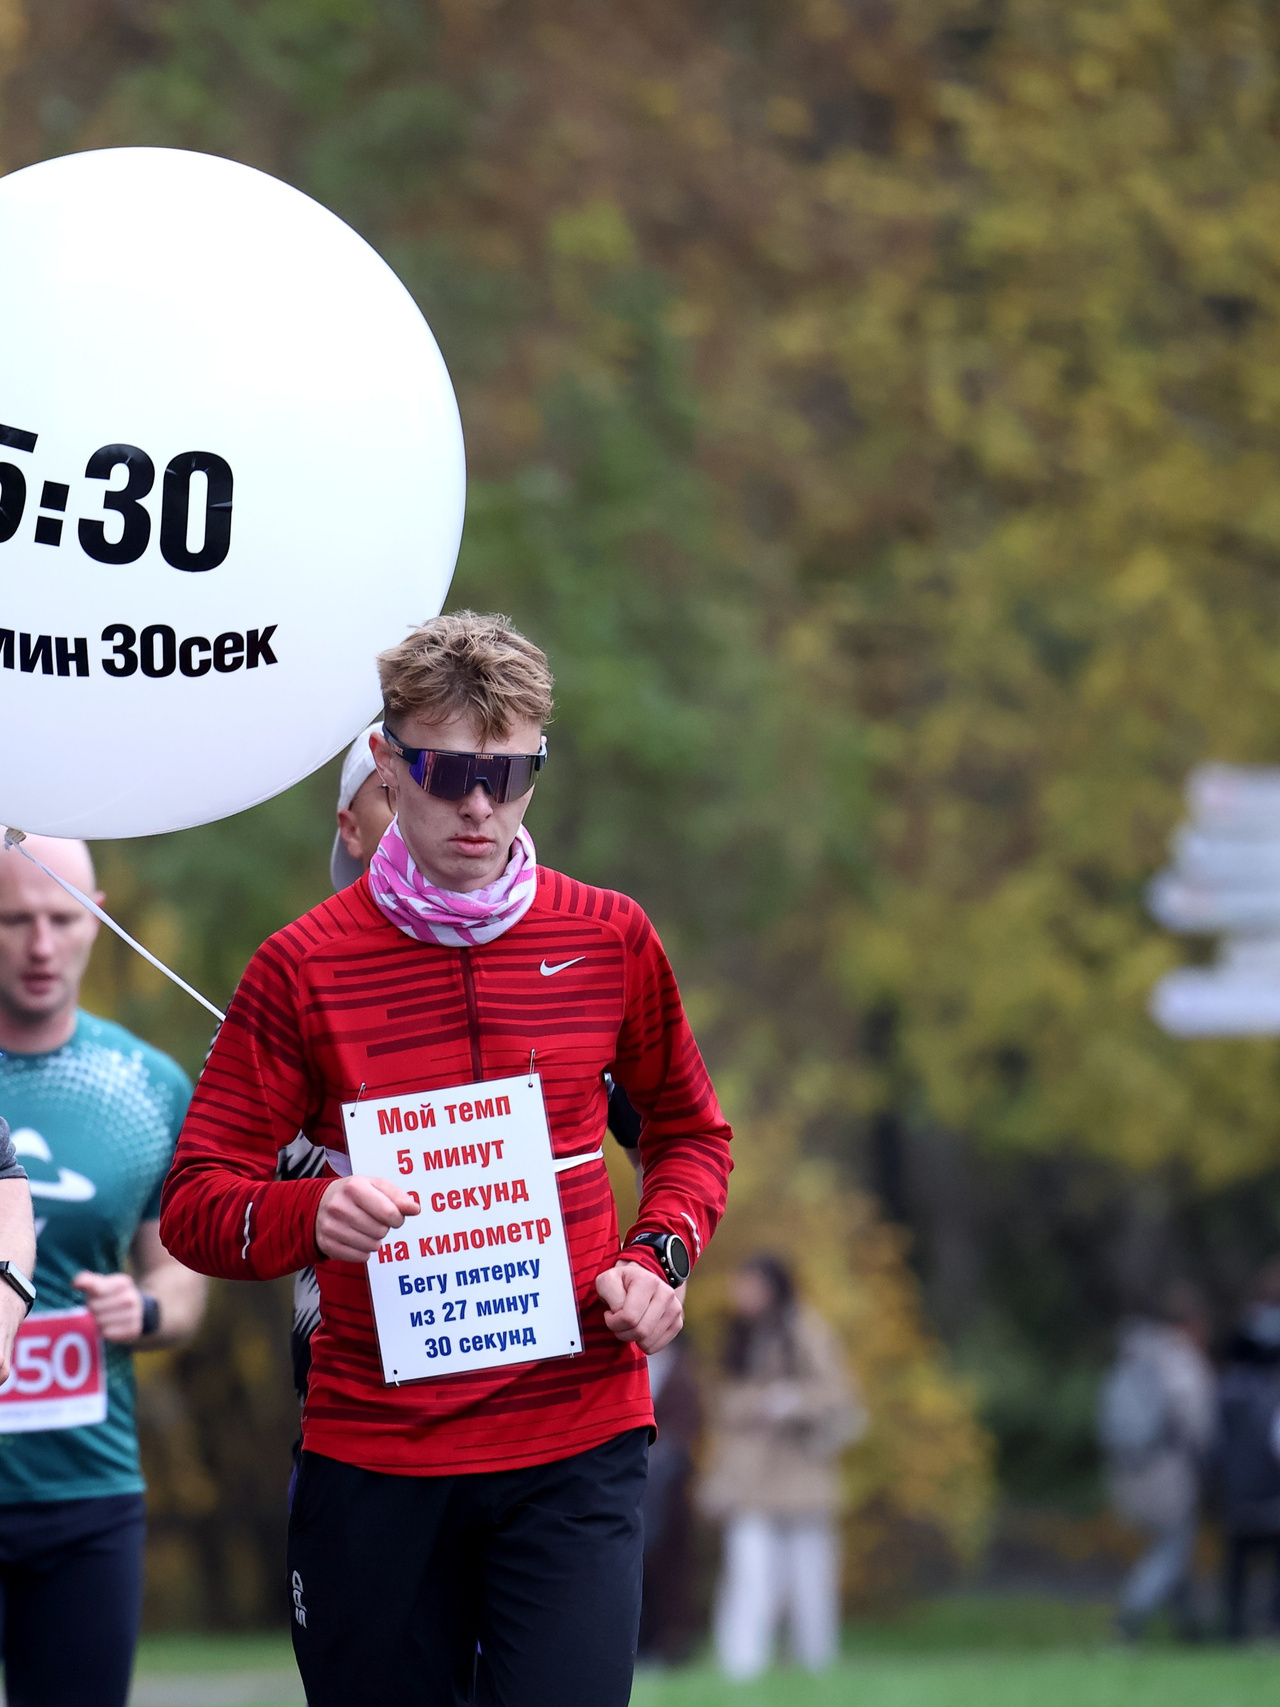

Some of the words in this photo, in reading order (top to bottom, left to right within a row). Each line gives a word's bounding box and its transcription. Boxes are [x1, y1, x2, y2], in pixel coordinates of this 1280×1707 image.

[101, 624, 279, 678] 30сек
[377, 1103, 437, 1136] Мой
[444, 1095, 512, 1125] темп
[397, 1149, 414, 1175] 5
[423, 1139, 505, 1171] минут
[431, 1179, 530, 1213] секунд
[377, 1239, 410, 1264] на
[419, 1217, 552, 1258] километр
[398, 1273, 448, 1296] Бегу
[455, 1258, 541, 1287] пятерку
[410, 1308, 436, 1328] из
[442, 1300, 468, 1323] 27
[476, 1292, 541, 1317] минут
[424, 1336, 452, 1359] 30
[459, 1326, 537, 1353] секунд
